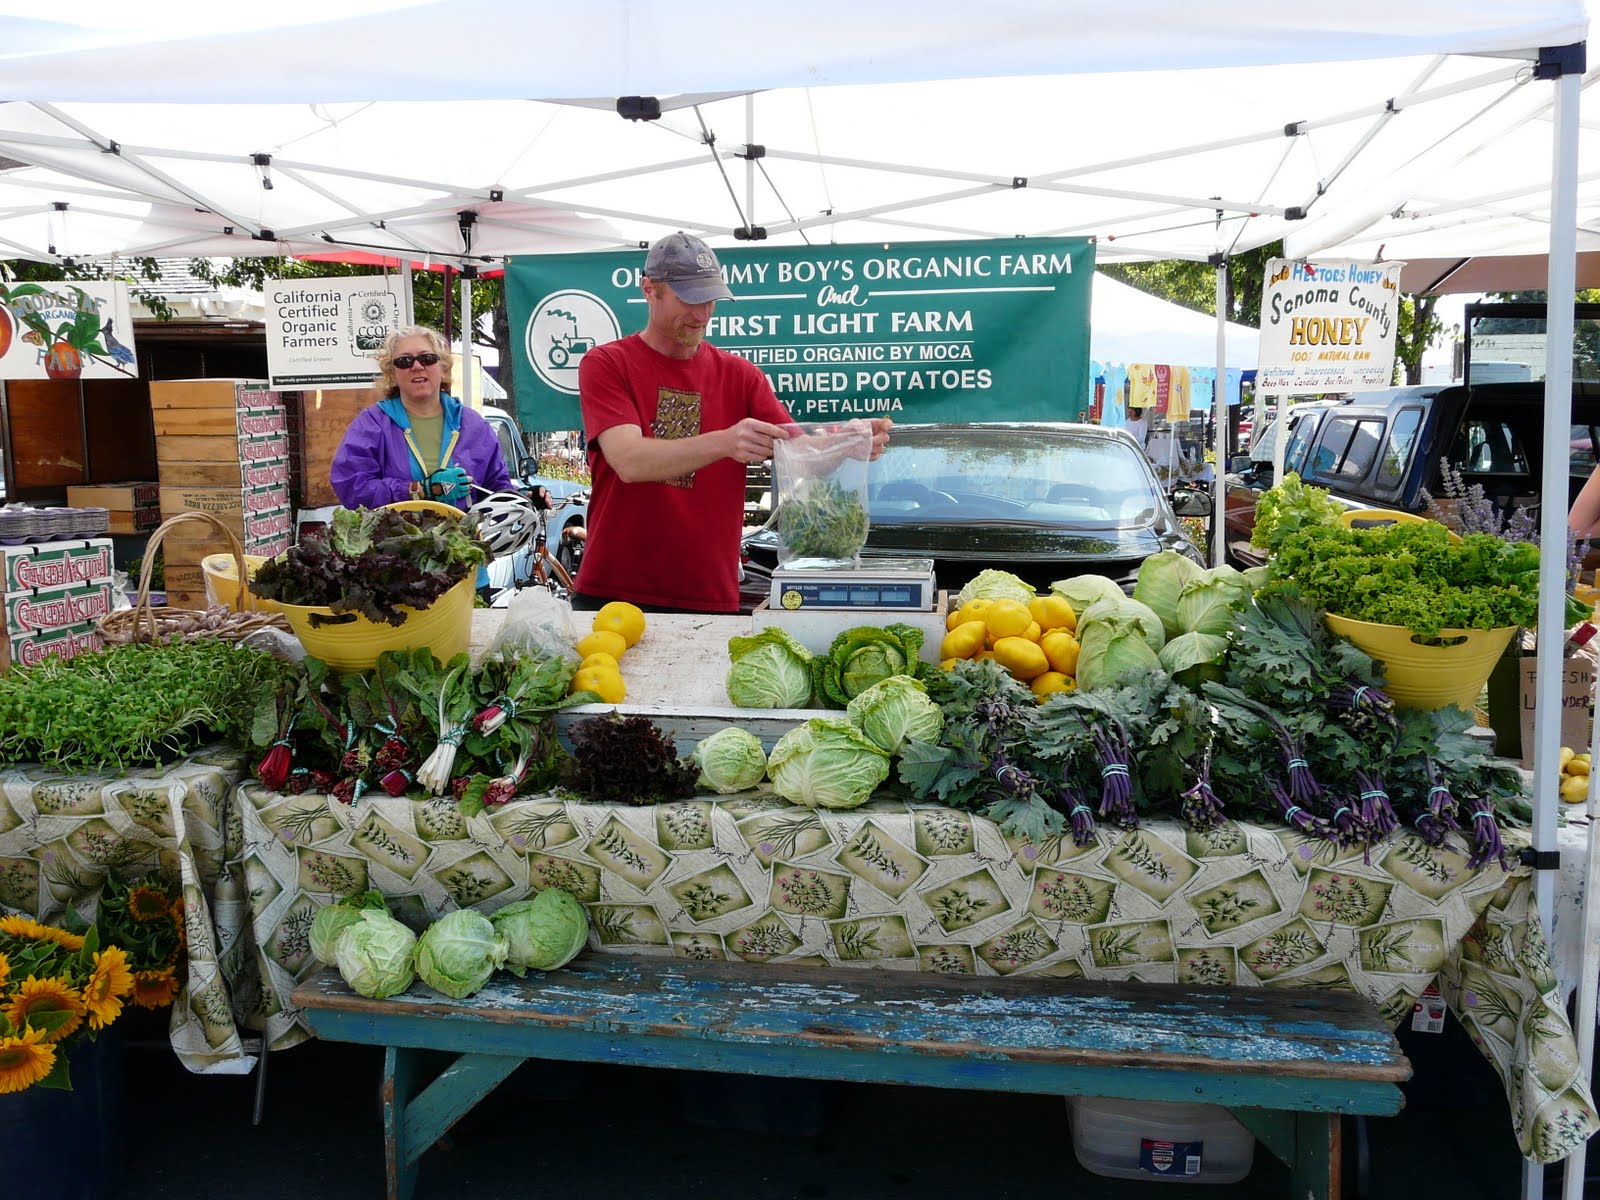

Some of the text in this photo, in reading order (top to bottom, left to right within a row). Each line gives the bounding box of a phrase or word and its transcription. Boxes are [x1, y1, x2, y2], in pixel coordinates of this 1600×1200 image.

[778, 260, 854, 282] BOY'S
[862, 256, 991, 280] ORGANIC
[1000, 253, 1072, 276] FARM
[1348, 264, 1383, 284] HONEY
[273, 290, 342, 304] California
[358, 290, 387, 298] Certified
[278, 304, 339, 319] Certified
[1270, 286, 1391, 339] Sonoma County
[282, 320, 337, 335] Organic
[358, 325, 389, 337] CCOF
[705, 310, 974, 337] FIRST LIGHT FARM
[1289, 317, 1370, 345] HONEY
[282, 336, 338, 348] Farmers
[36, 348, 95, 370] FARM
[803, 346, 884, 362] ORGANIC
[890, 346, 914, 360] BY
[920, 345, 972, 360] MOCA
[1317, 351, 1351, 361] NATURAL
[1353, 351, 1372, 361] RAW
[765, 369, 992, 393] ARMED POTATOES
[806, 398, 903, 413] PETALUMA
[76, 546, 110, 580] FRUITS
[77, 587, 110, 621] FRUITS
